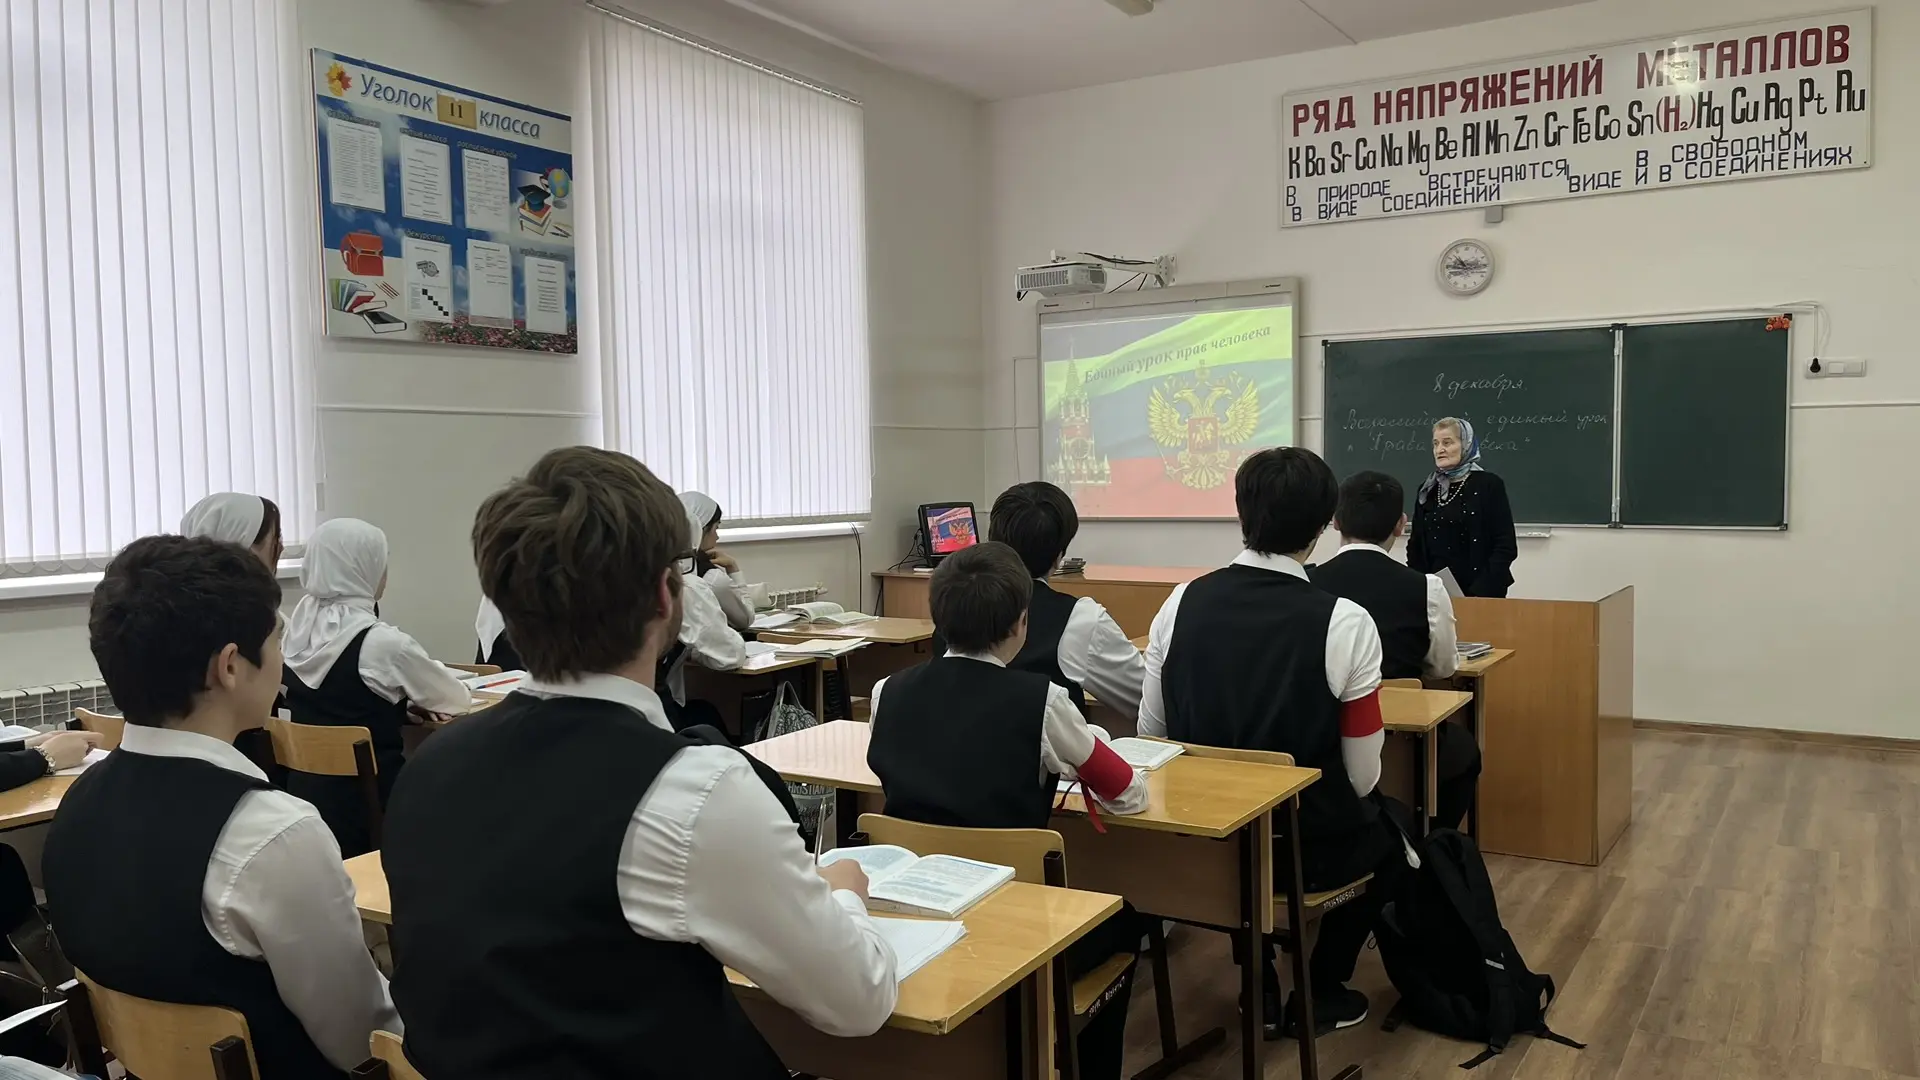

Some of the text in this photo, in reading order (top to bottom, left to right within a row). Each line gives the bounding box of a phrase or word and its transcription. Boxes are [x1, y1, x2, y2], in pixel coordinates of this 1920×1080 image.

[361, 73, 435, 113] Уголок
[480, 109, 540, 139] класса
[1293, 96, 1356, 137] РЯД
[1374, 54, 1604, 126] НАПРЯЖЕНИЙ
[1305, 145, 1325, 177] Ba
[1331, 140, 1352, 173] Sr
[1355, 137, 1377, 171] Ca
[1380, 133, 1403, 167] Na
[1408, 129, 1430, 176] Mg
[1435, 126, 1458, 160] Be
[1462, 122, 1480, 158] Al
[1485, 119, 1509, 155] Mn
[1514, 115, 1538, 151] Zn
[1544, 111, 1568, 147] Cr
[1573, 107, 1591, 144] Fe
[1594, 104, 1621, 141] Co
[1627, 100, 1654, 137] Sn
[1697, 91, 1724, 142] Hg
[1732, 87, 1759, 125] Cu
[1764, 82, 1793, 134] Ag
[1799, 77, 1827, 117] Pt
[1835, 69, 1866, 113] Au
[1569, 146, 1852, 193] ВИДЕ И В СОЕДИНЕНИЯХ
[1636, 131, 1807, 168] В СВОБОДНОМ
[1286, 186, 1297, 207] В
[1318, 179, 1391, 203] ПРИРОДЕ
[1292, 184, 1500, 222] В ВИДЕ СОЕДИНЕНИЙ
[1084, 326, 1271, 384] Единый урок прав человека
